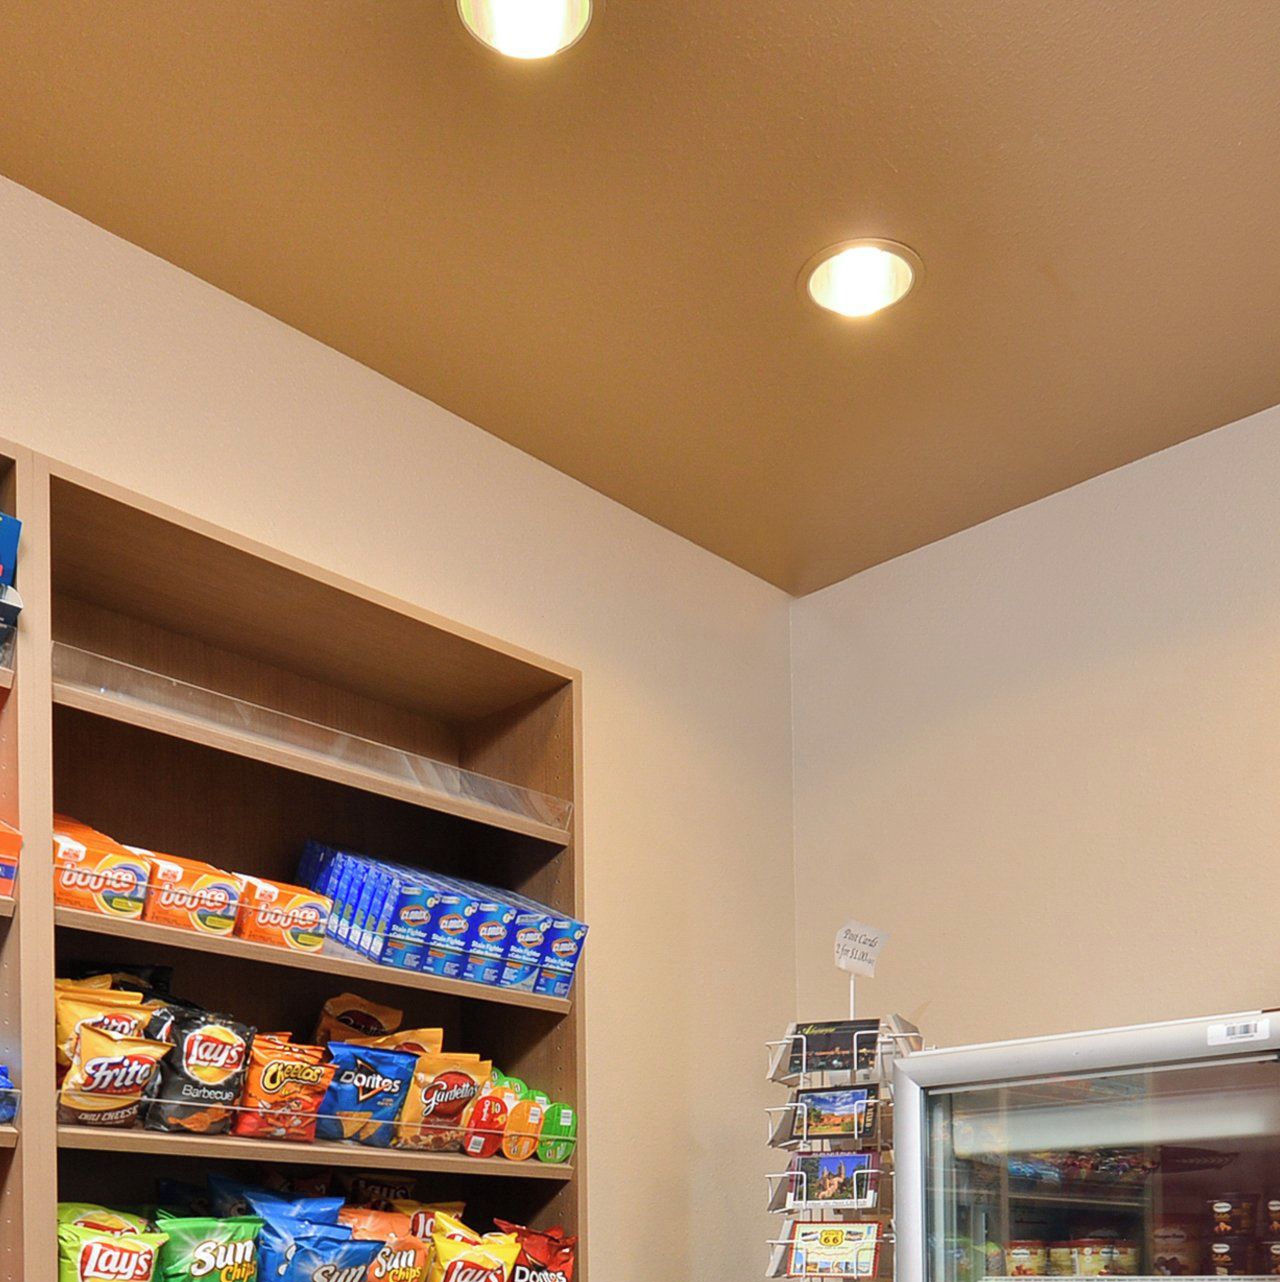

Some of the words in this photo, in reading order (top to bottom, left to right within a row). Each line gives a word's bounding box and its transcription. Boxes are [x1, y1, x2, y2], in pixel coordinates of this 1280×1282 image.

[60, 861, 135, 892] bounce
[160, 883, 227, 911] bounce
[257, 904, 319, 928] bounce
[187, 1035, 244, 1069] Lay's
[262, 1061, 323, 1091] Cheetos
[340, 1071, 402, 1093] Doritos
[182, 1084, 234, 1101] Barbecue
[421, 1079, 481, 1117] Gardetto's
[102, 1106, 139, 1121] CHEESE
[83, 1243, 152, 1280] Lay's
[190, 1239, 255, 1277] Sun
[374, 1247, 416, 1280] Sun
